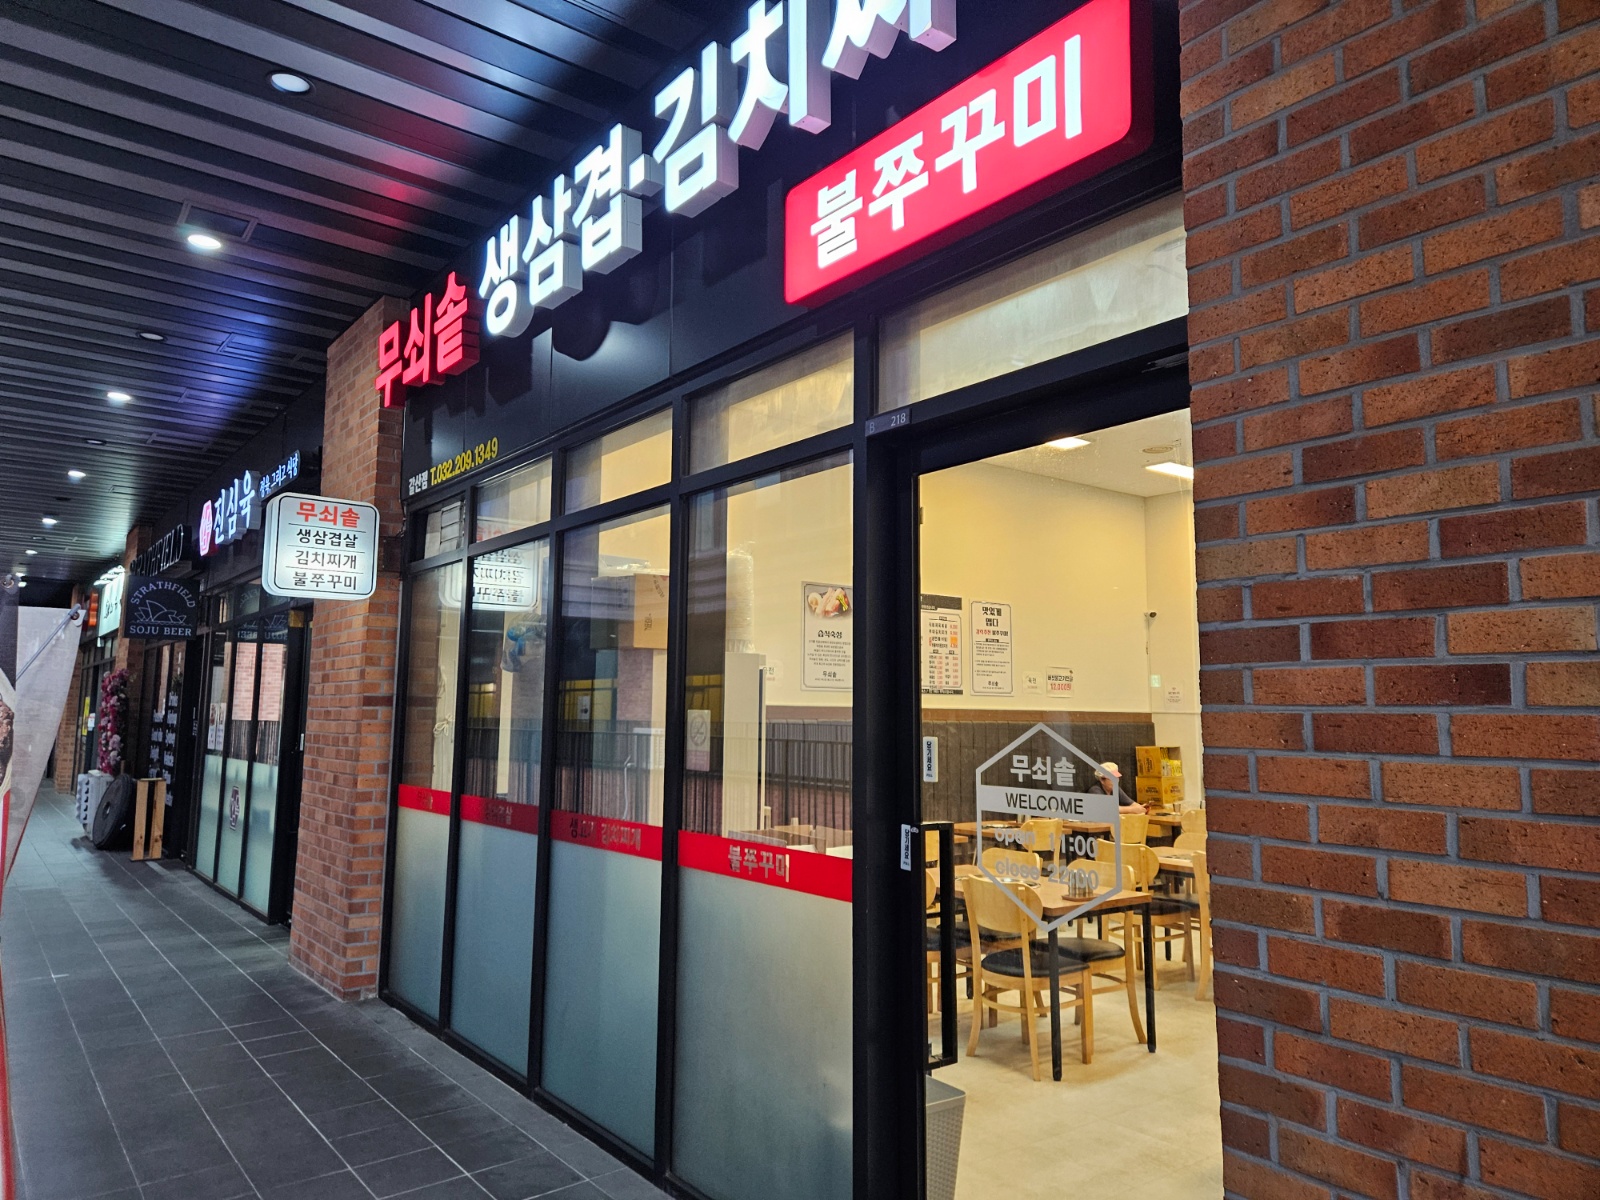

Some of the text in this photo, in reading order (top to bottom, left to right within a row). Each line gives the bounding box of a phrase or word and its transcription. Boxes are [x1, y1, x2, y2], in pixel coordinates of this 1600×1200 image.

[810, 34, 1082, 270] 불쭈꾸미
[375, 271, 468, 408] 무쇠솥
[890, 412, 906, 427] 218
[286, 453, 299, 479] 식당
[409, 437, 498, 496] 갈산점 T.032.209.1349
[213, 470, 255, 545] 진심육
[297, 501, 360, 528] 무쇠솥
[297, 528, 358, 549] 생삼겹살
[295, 550, 357, 570] 김치찌개
[293, 571, 356, 590] 불쭈꾸미
[130, 581, 196, 608] STRATHFIELD
[129, 625, 192, 636] SOJU BEER
[1010, 754, 1076, 787] 무쇠솥
[1005, 792, 1084, 815] WELCOME
[1048, 832, 1099, 858] 11:00
[728, 844, 790, 883] 불쭈꾸미
[994, 857, 1041, 881] close
